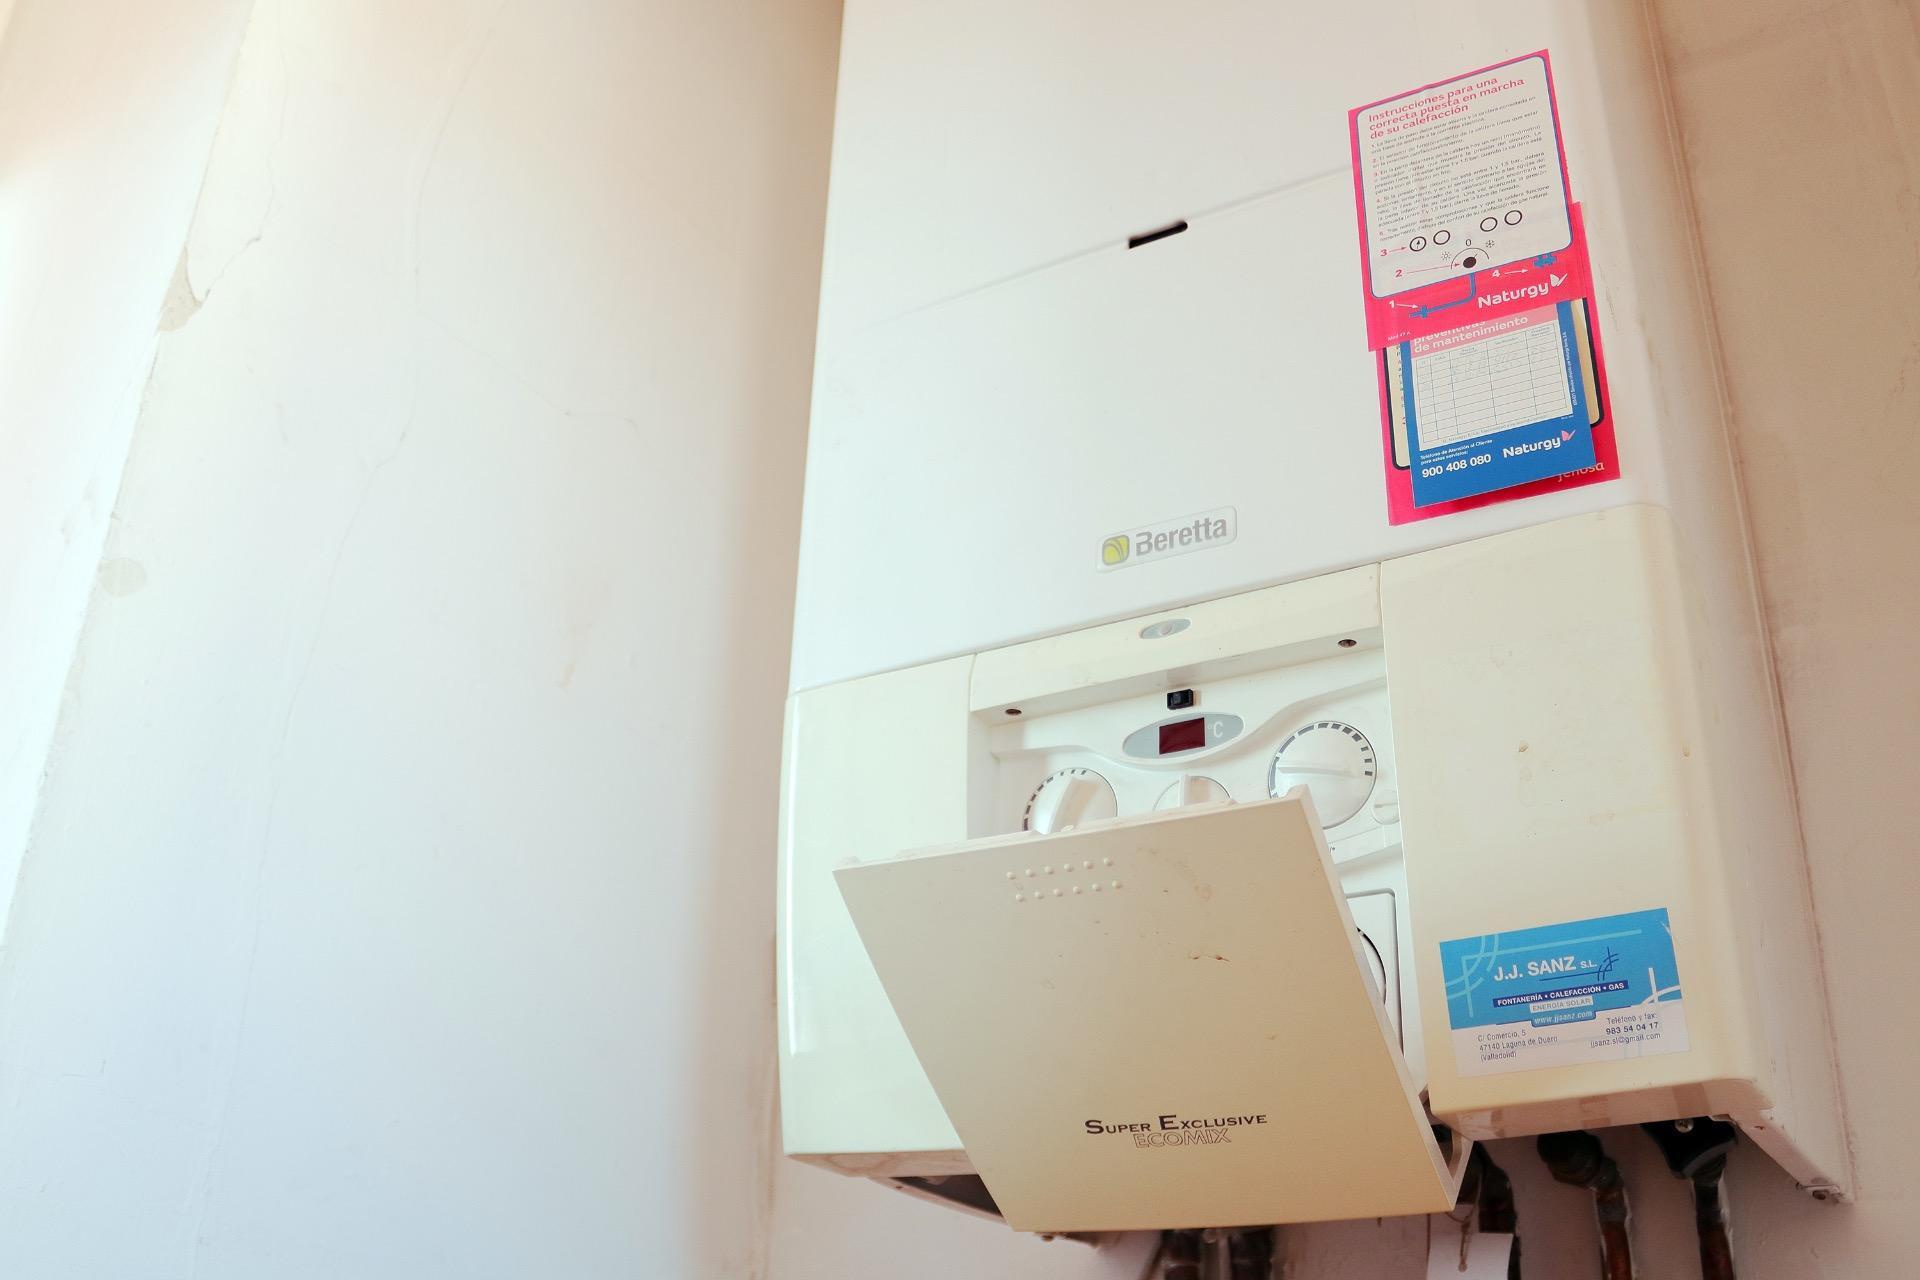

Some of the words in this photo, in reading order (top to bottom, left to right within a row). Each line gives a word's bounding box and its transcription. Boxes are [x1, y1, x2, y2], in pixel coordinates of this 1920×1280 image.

[1369, 95, 1444, 121] Instrucciones
[1447, 85, 1473, 101] para
[1476, 78, 1497, 88] una
[1369, 111, 1416, 130] correcta
[1420, 98, 1459, 117] puesta
[1462, 93, 1476, 101] en
[1479, 79, 1524, 96] marcha
[1370, 130, 1383, 138] de
[1387, 125, 1399, 134] su
[1402, 105, 1468, 128] calefacción
[1380, 248, 1388, 256] 3
[1465, 238, 1471, 246] 0
[1393, 269, 1402, 277] 2
[1492, 269, 1500, 277] 4
[1478, 283, 1548, 307] Naturgy
[1413, 341, 1429, 354] de
[1433, 317, 1528, 347] mantenimiento
[1475, 437, 1493, 447] Cliente
[1503, 437, 1560, 457] Naturgy
[1421, 464, 1443, 479] 900
[1445, 458, 1467, 473] 408
[1469, 452, 1491, 467] 080
[1136, 517, 1227, 556] Beretta
[1494, 964, 1522, 980] J.J.
[1526, 955, 1577, 977] SANZ
[1580, 959, 1597, 968] S.L.
[1497, 994, 1543, 1006] FONTANERÍA
[1550, 985, 1601, 999] CALEFACCIÓN
[1607, 981, 1625, 991] GAS
[1565, 997, 1591, 1006] SOLAR
[1604, 1025, 1621, 1036] 983
[1649, 1021, 1658, 1029] 17
[1479, 1042, 1500, 1050] 47140
[1500, 1038, 1527, 1049] Laguna
[1133, 1128, 1232, 1148] ECOMIX
